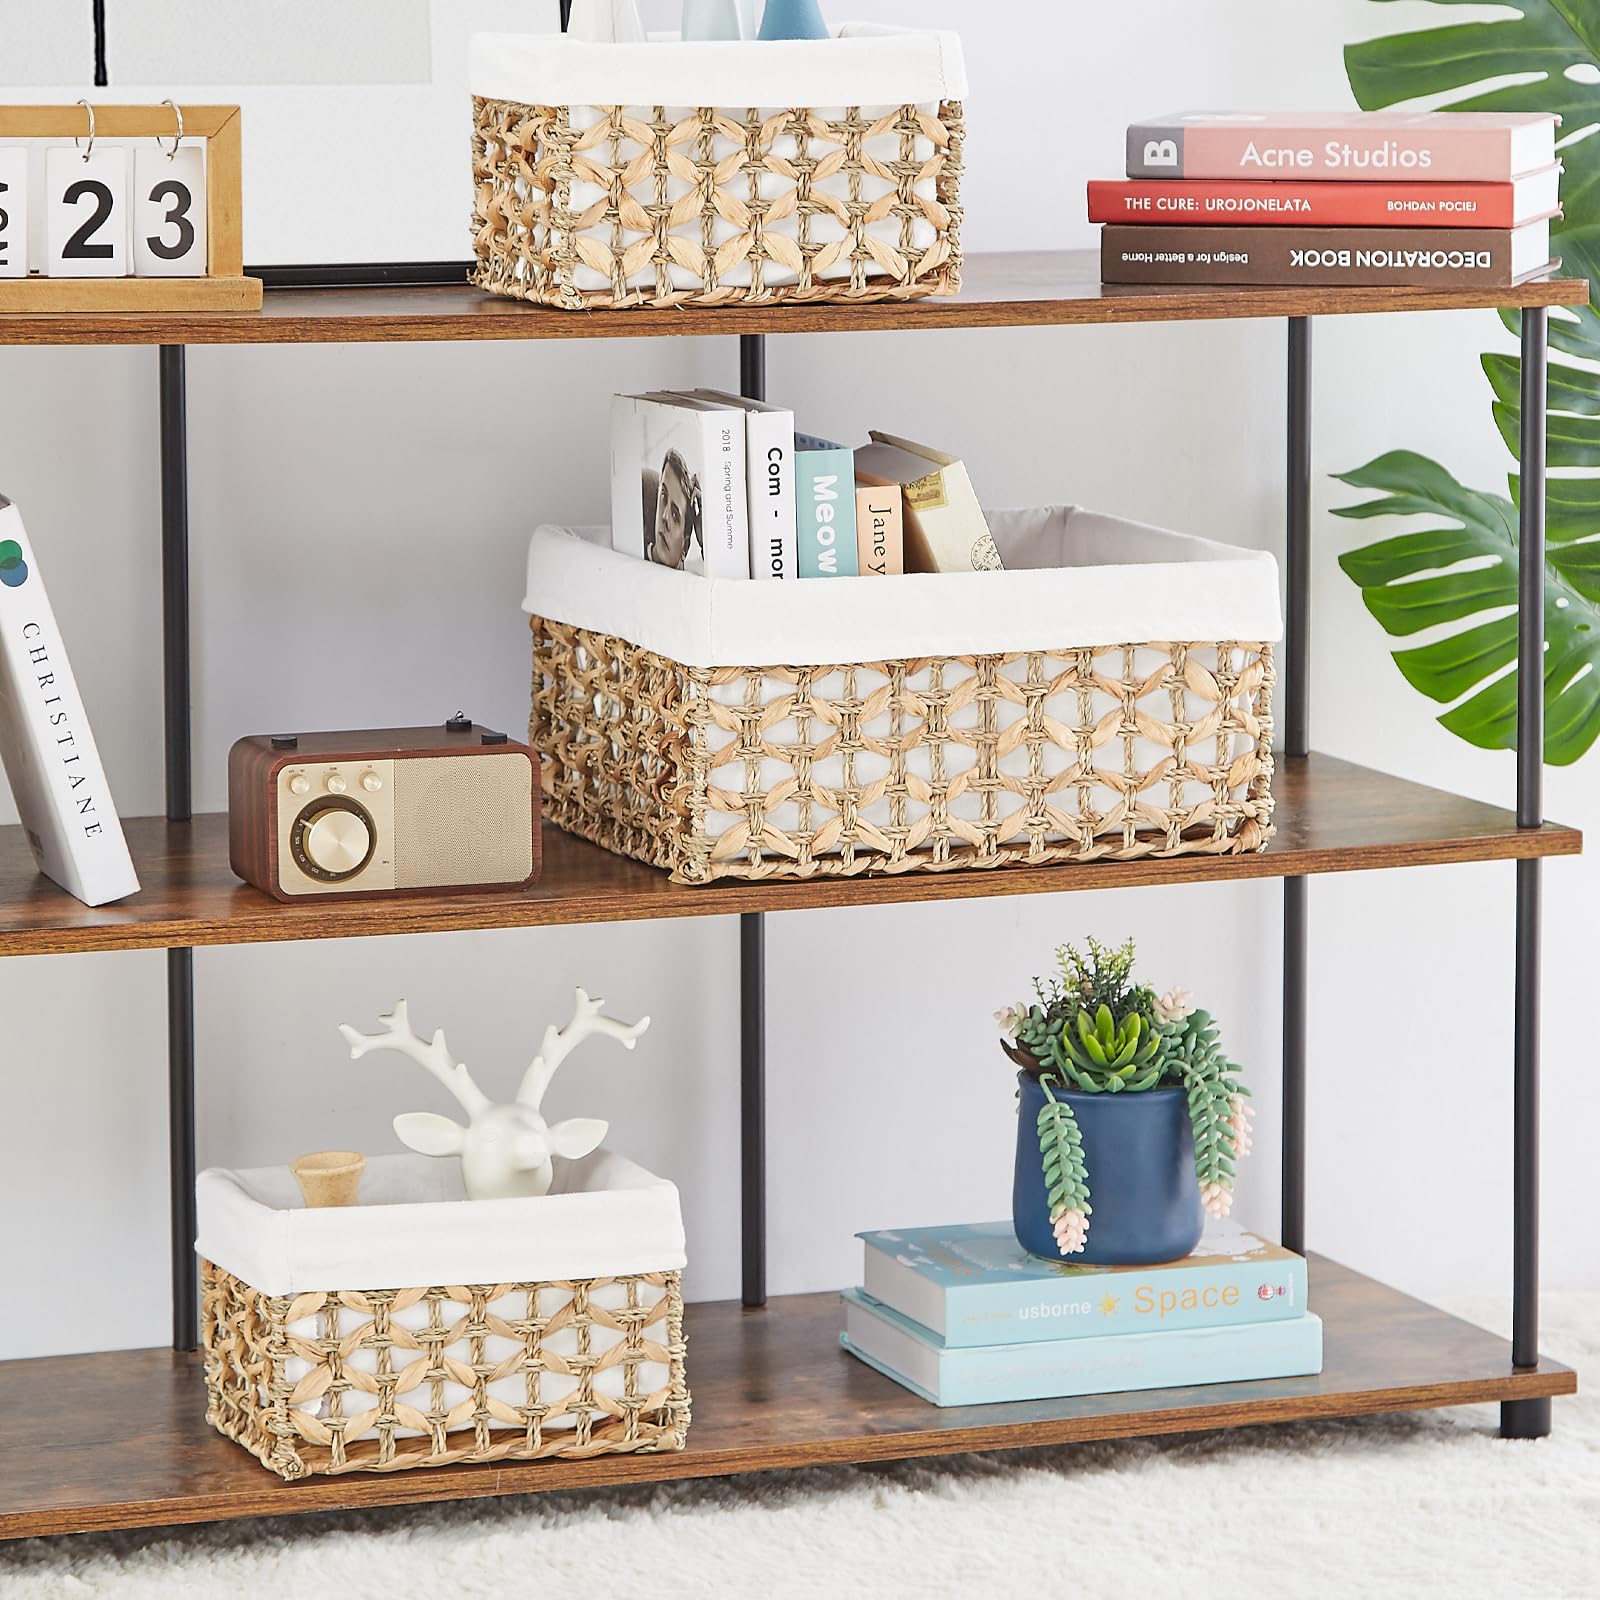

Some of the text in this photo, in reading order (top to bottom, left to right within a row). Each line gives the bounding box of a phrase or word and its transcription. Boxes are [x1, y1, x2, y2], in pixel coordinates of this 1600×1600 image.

[1143, 138, 1178, 166] B
[1239, 140, 1432, 168] Acne Studios
[1124, 197, 1312, 212] THE CURE: UROJONELATA
[1387, 200, 1477, 212] BOHDAN POCIEJ
[61, 179, 114, 259] 2
[146, 179, 195, 260] 3
[1121, 252, 1249, 264] Design for a Better Home
[1290, 249, 1491, 268] DECORATION BOOK
[721, 429, 731, 452] 2018
[723, 461, 732, 492] Spring
[767, 447, 783, 496] Com
[725, 493, 734, 513] and
[812, 475, 839, 574] Meow
[22, 622, 103, 839] CHRISTIANE
[1019, 1283, 1240, 1320] usborne Space
